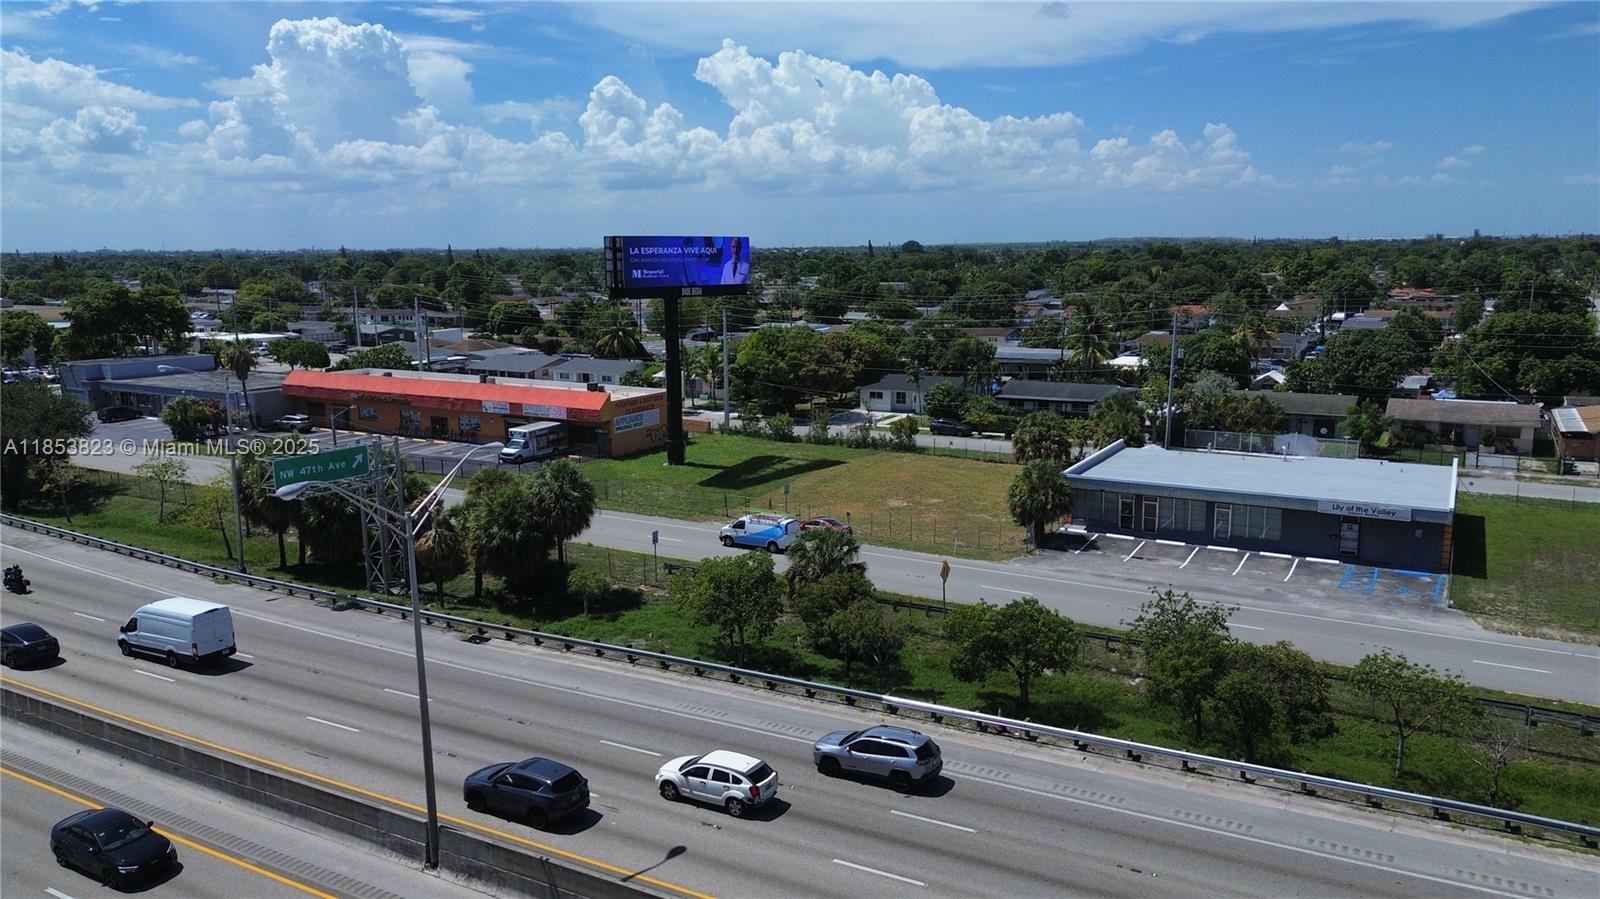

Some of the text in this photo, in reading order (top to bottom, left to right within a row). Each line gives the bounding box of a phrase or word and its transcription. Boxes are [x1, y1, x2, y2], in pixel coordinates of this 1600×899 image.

[629, 247, 640, 255] LA
[640, 247, 682, 255] ESPERANZA
[683, 247, 699, 255] VIVE
[632, 269, 642, 279] M
[280, 461, 346, 479] NW 47th Ave
[1332, 503, 1344, 512] Lily
[1346, 503, 1355, 512] of
[1355, 505, 1369, 514] the
[1371, 506, 1397, 517] Valley
